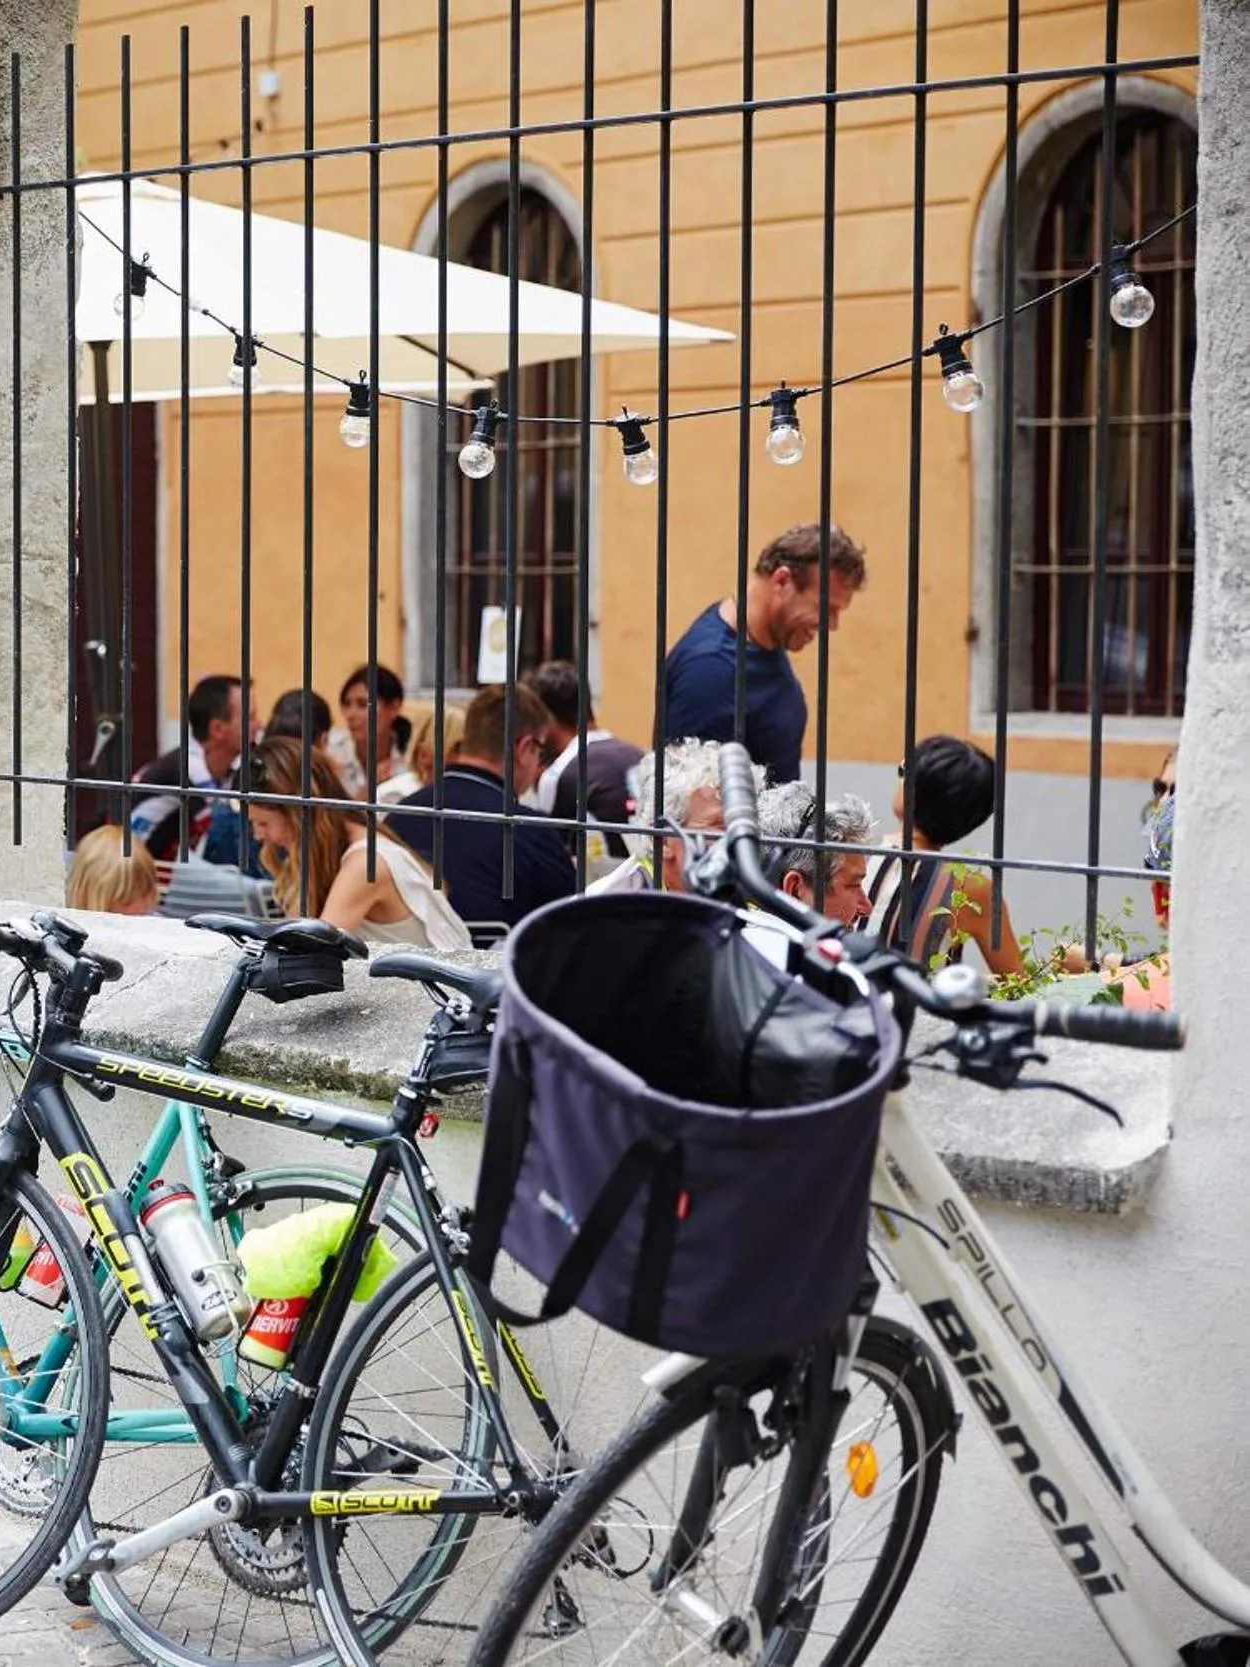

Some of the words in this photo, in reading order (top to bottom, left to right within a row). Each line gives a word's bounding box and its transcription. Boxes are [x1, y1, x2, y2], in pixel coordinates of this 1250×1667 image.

[249, 1314, 300, 1335] NERVIT
[937, 1198, 1047, 1373] SPILLO
[920, 1297, 1126, 1598] Bianchi
[342, 1490, 436, 1511] SCOTT
